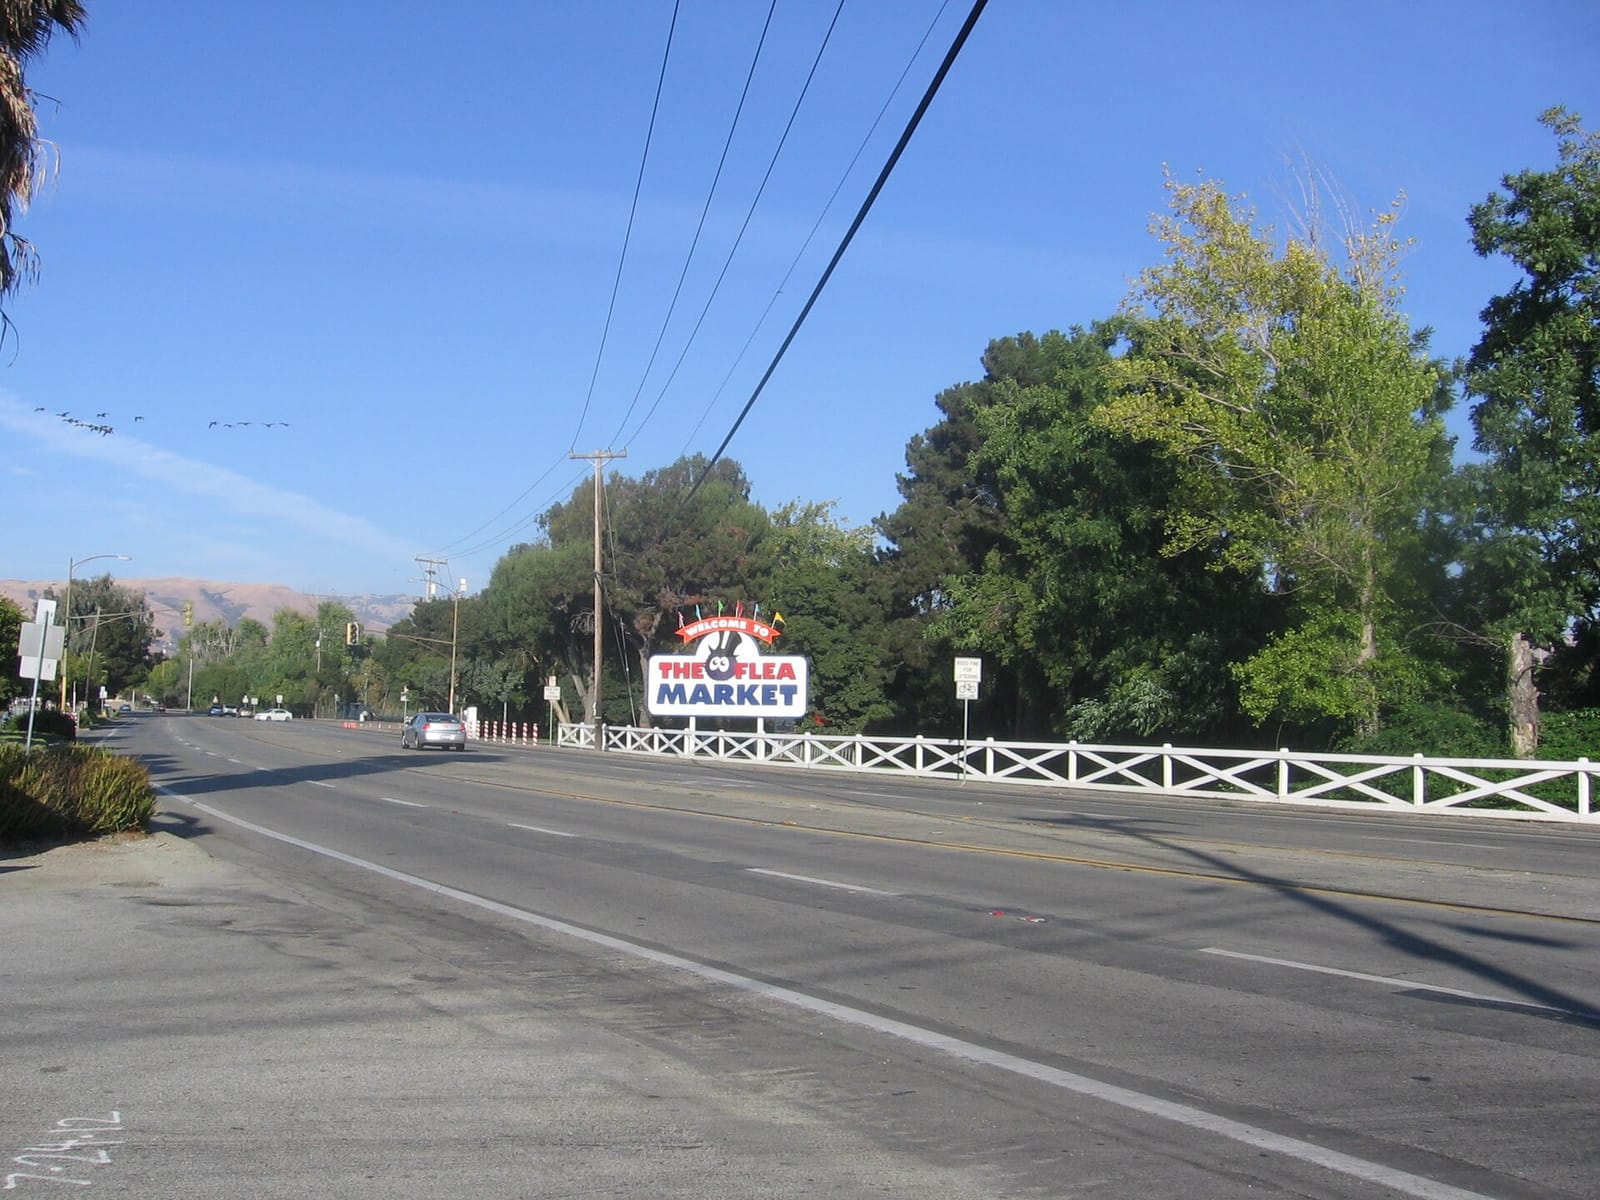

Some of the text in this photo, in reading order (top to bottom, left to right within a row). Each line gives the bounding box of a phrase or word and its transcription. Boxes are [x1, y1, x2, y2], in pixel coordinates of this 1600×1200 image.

[685, 619, 769, 637] WELCOME TO
[658, 662, 796, 680] THE FLEA
[656, 683, 798, 706] MARKET
